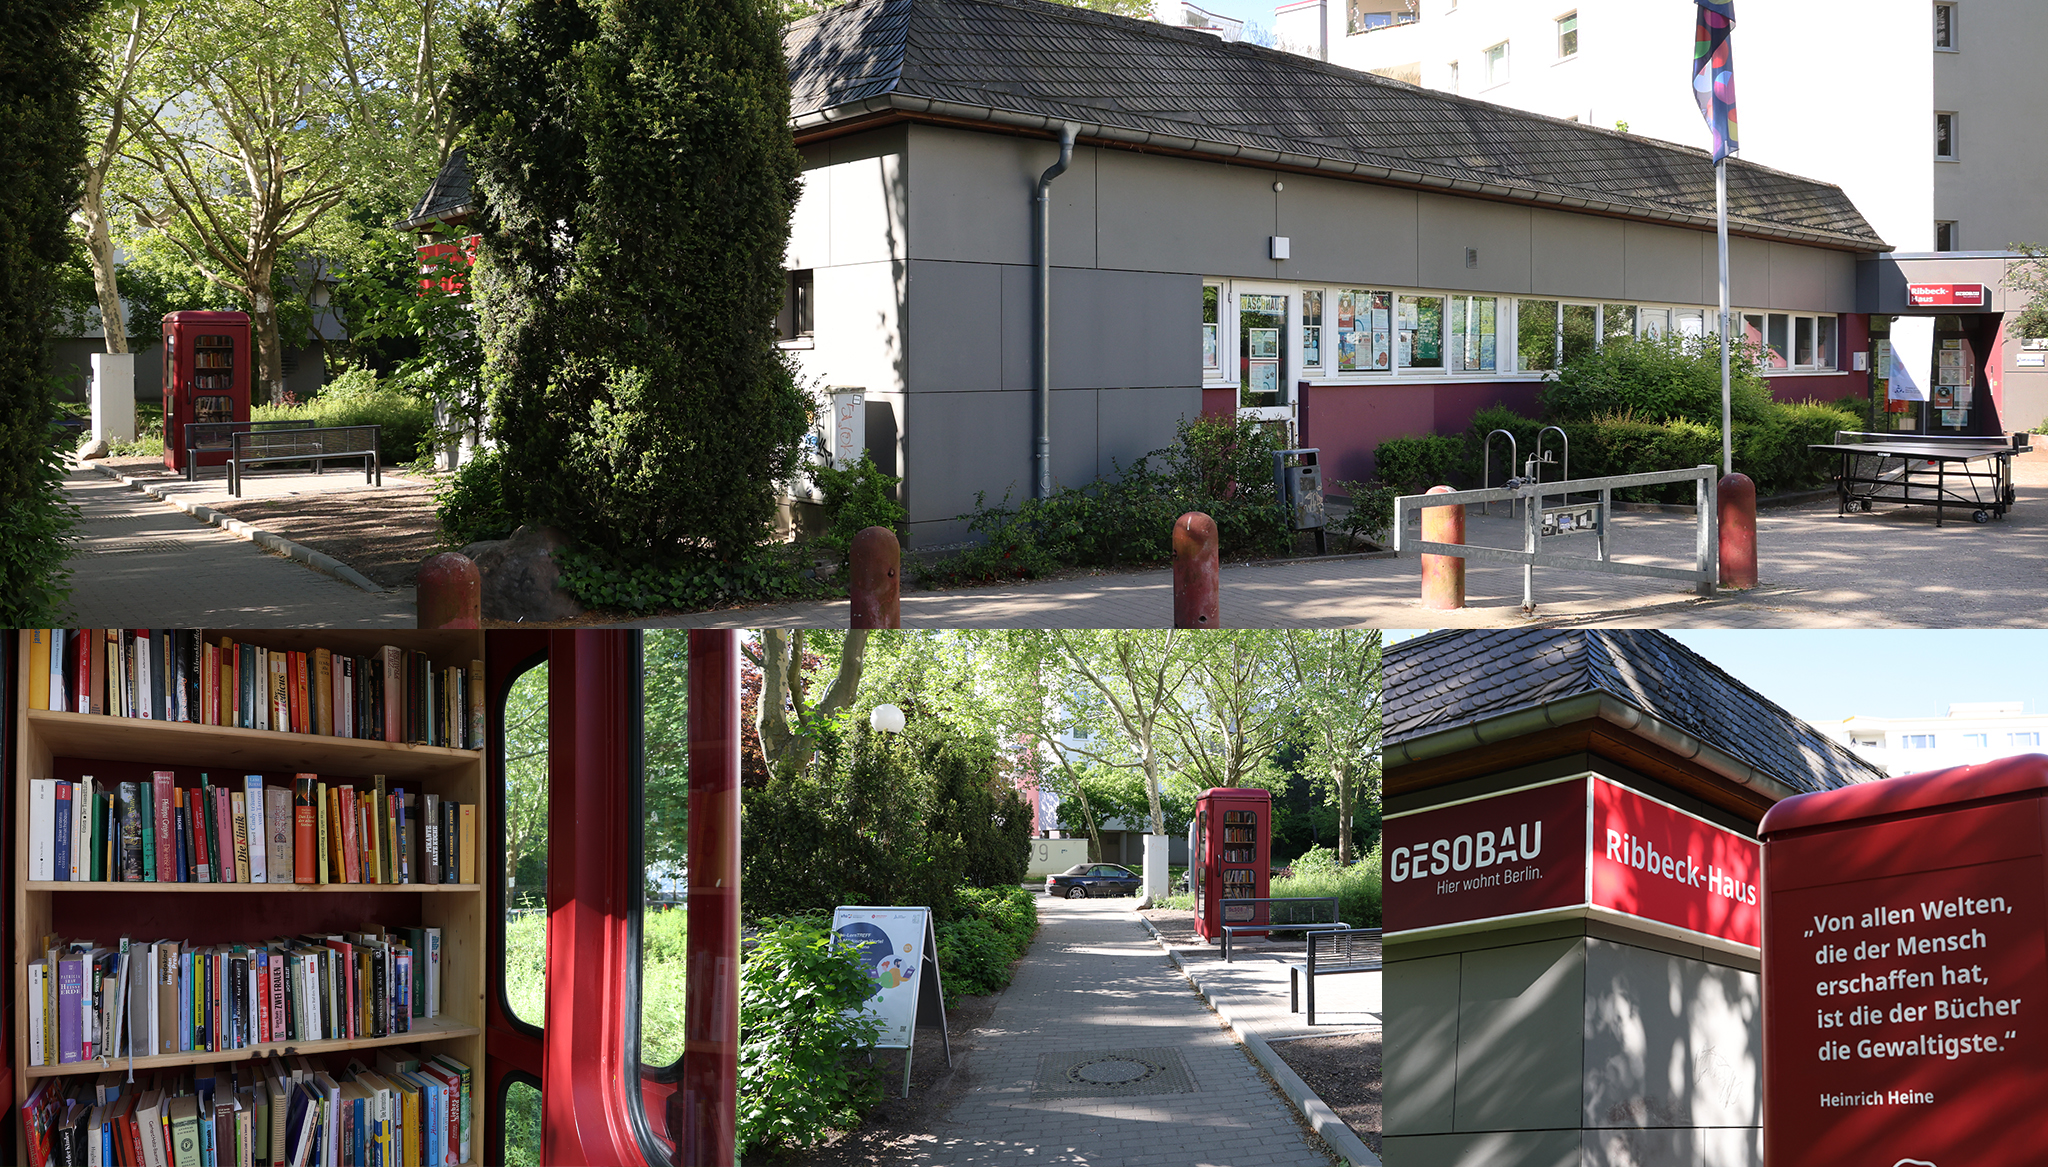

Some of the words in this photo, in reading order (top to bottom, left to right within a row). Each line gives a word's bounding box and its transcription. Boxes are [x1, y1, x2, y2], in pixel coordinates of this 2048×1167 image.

[1911, 287, 1949, 295] Ribbeck-
[274, 675, 287, 716] Medicus
[235, 816, 246, 845] Klinik
[237, 845, 247, 863] Die
[1390, 820, 1543, 884] GESOBAU
[1605, 828, 1757, 907] Ribbeck-Haus
[1436, 877, 1459, 896] Hier
[1463, 873, 1501, 891] wohnt
[1503, 866, 1544, 886] Berlin.
[1804, 912, 1856, 939] „Von
[1860, 905, 1916, 929] allen
[1920, 894, 2014, 923] Welten,
[1814, 942, 1846, 966] die
[1852, 938, 1890, 962] der
[1896, 929, 1988, 955] Mensch
[168, 975, 172, 985] Um
[1815, 965, 1935, 997] erschaffen
[1941, 962, 1990, 989] hat,
[274, 992, 282, 1009] ZWEI
[1816, 1007, 1843, 1030] ist
[1848, 1004, 1883, 1028] die
[1888, 1000, 1928, 1025] der
[1933, 994, 2021, 1022] Bücher
[1818, 1039, 1851, 1062] die
[1856, 1030, 2017, 1066] Gewaltigste.“
[1819, 1089, 1884, 1109] Heinrich
[1887, 1087, 1934, 1106] Heine
